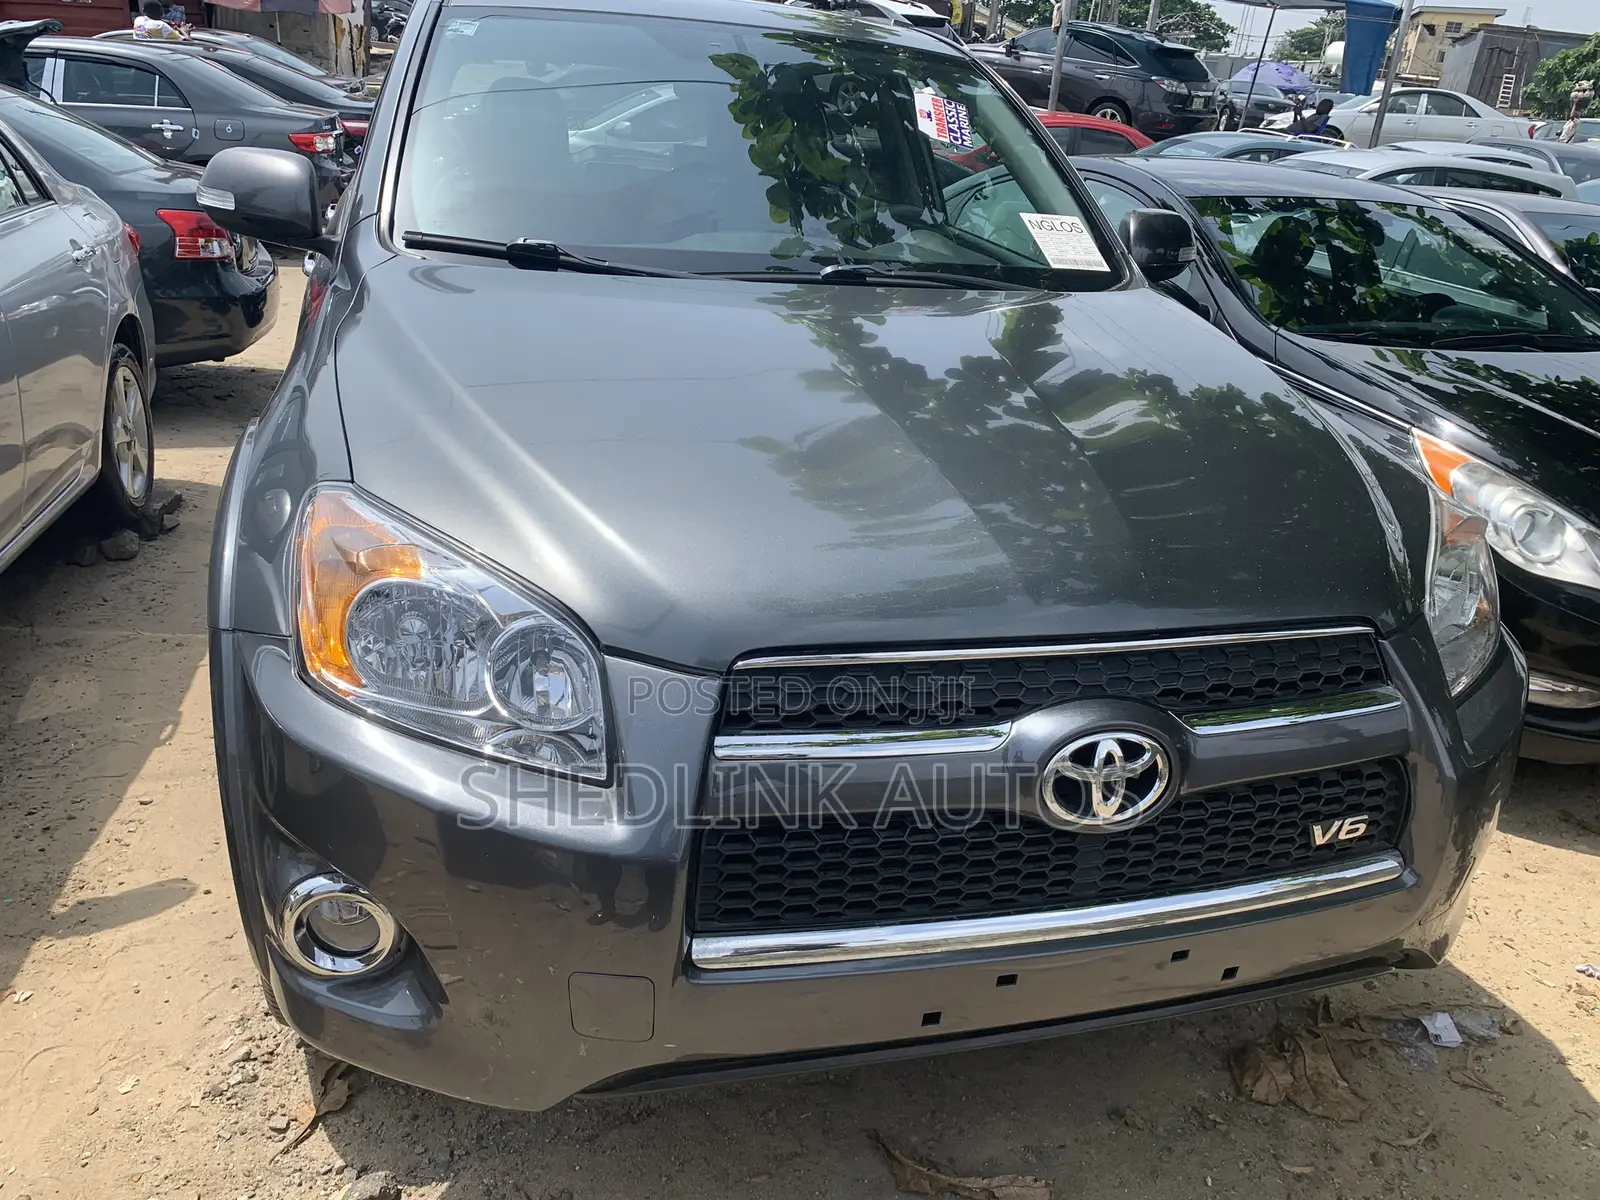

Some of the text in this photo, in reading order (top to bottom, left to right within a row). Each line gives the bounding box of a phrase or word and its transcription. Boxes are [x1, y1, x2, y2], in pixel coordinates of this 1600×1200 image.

[931, 97, 949, 140] TRANSFER
[944, 99, 962, 145] CLASSIC
[956, 103, 974, 147] MARINE
[1028, 219, 1084, 234] NGLOS
[1312, 814, 1369, 846] V6
